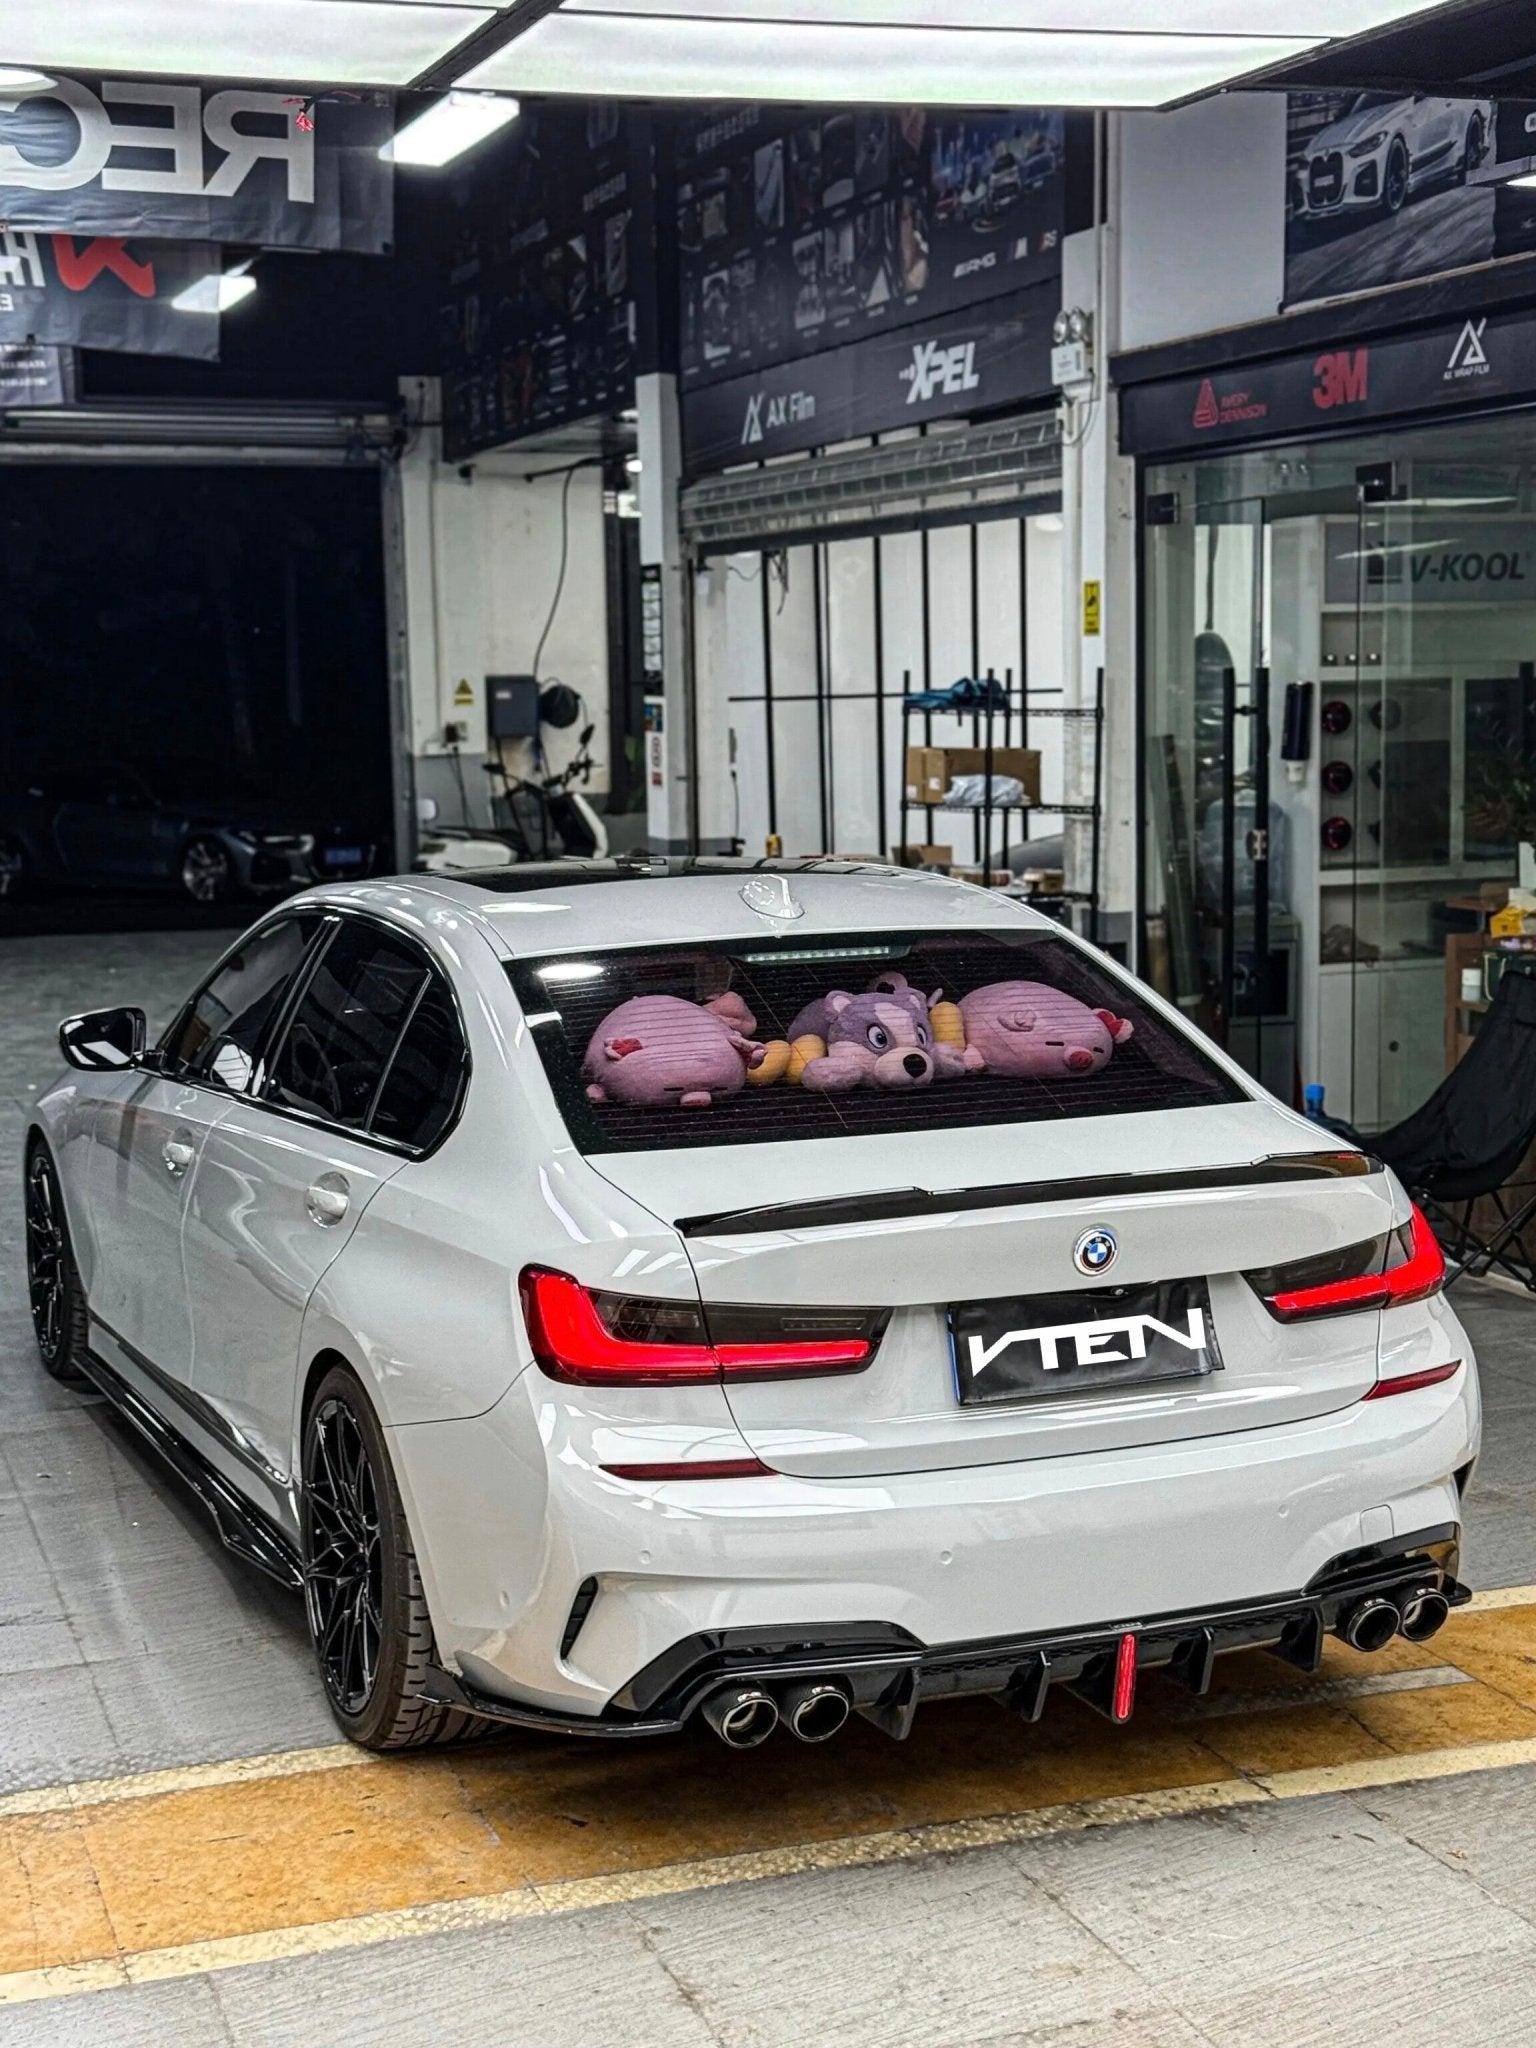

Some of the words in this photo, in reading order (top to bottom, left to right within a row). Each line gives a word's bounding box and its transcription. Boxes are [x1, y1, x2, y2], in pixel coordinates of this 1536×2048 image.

[905, 340, 980, 404] XPEL
[1312, 348, 1368, 409] 3M
[766, 396, 787, 428] AX
[1411, 552, 1525, 583] V-KOOL
[968, 1308, 1206, 1377] VTEN
